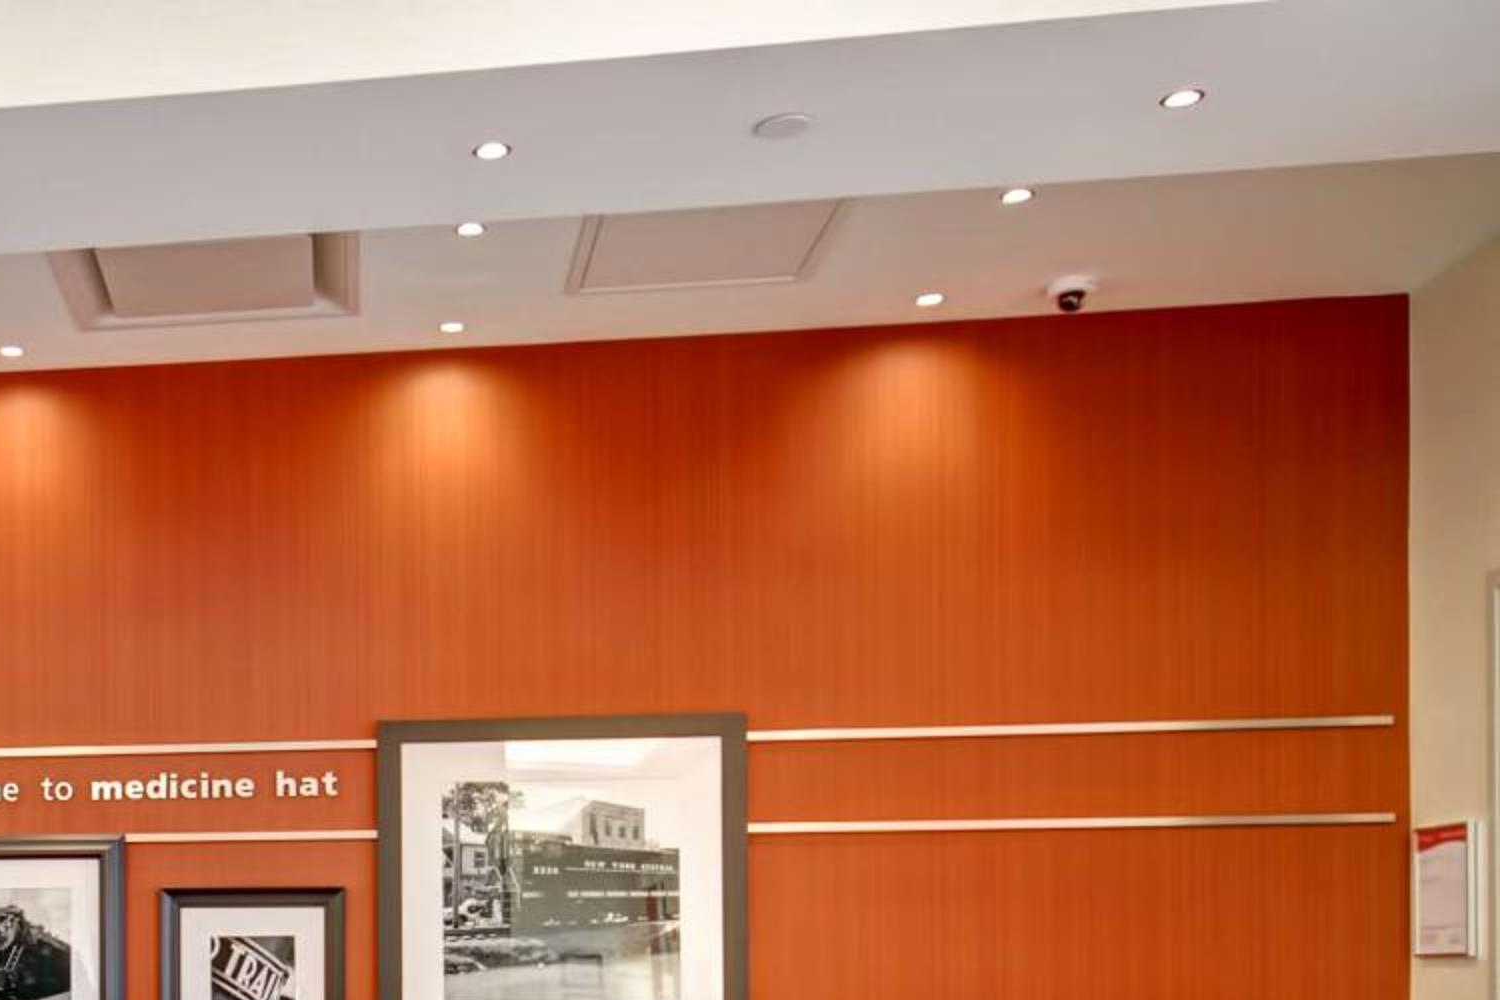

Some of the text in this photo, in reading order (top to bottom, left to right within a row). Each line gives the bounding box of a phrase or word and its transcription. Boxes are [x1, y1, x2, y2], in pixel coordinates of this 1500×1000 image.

[41, 777, 73, 801] to
[91, 772, 255, 801] medicine
[275, 771, 339, 798] hat
